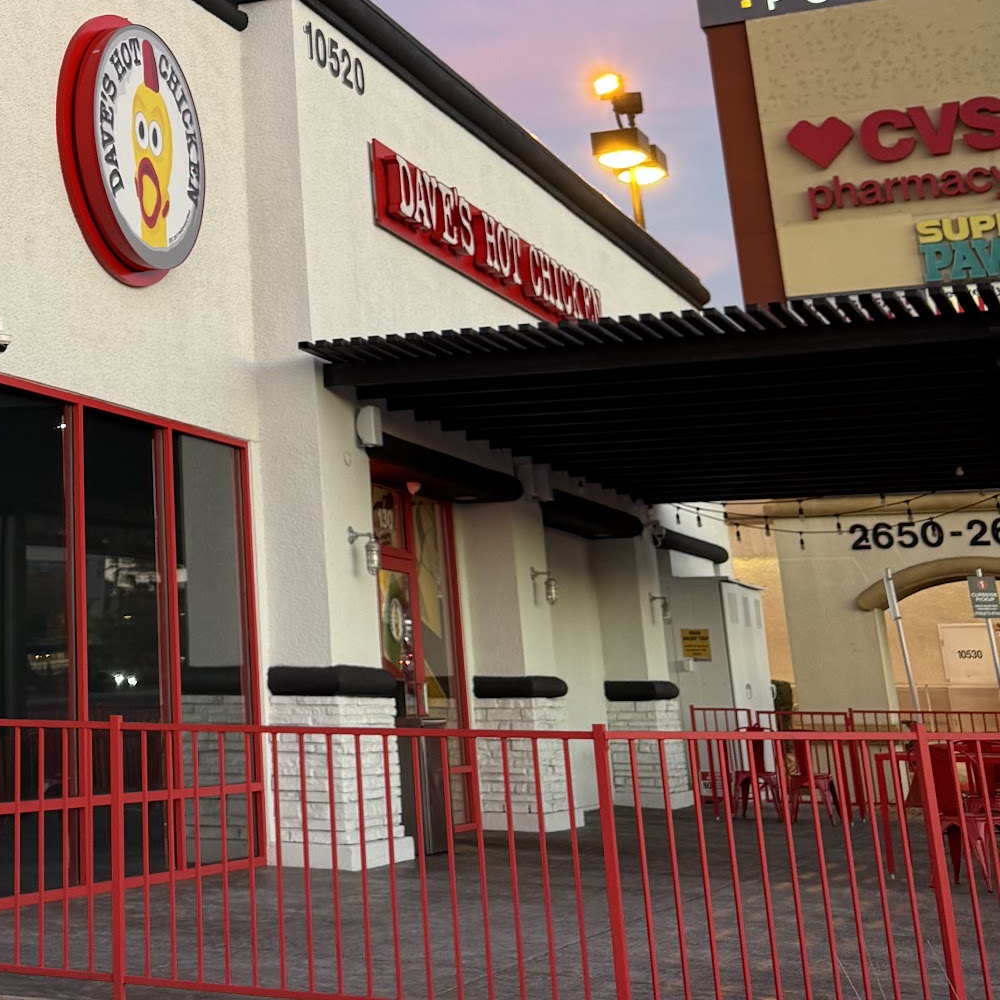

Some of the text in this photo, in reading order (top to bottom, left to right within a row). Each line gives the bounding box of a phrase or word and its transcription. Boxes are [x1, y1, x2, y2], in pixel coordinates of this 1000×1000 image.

[109, 37, 142, 83] HOT
[303, 21, 365, 96] 10520
[99, 73, 125, 199] DAVE'S
[158, 53, 201, 208] CHICKEN
[859, 96, 1000, 164] CVS
[395, 154, 475, 257] DAVE'S
[480, 211, 523, 286] HOT
[916, 212, 1000, 244] SUP
[957, 649, 983, 660] 10530
